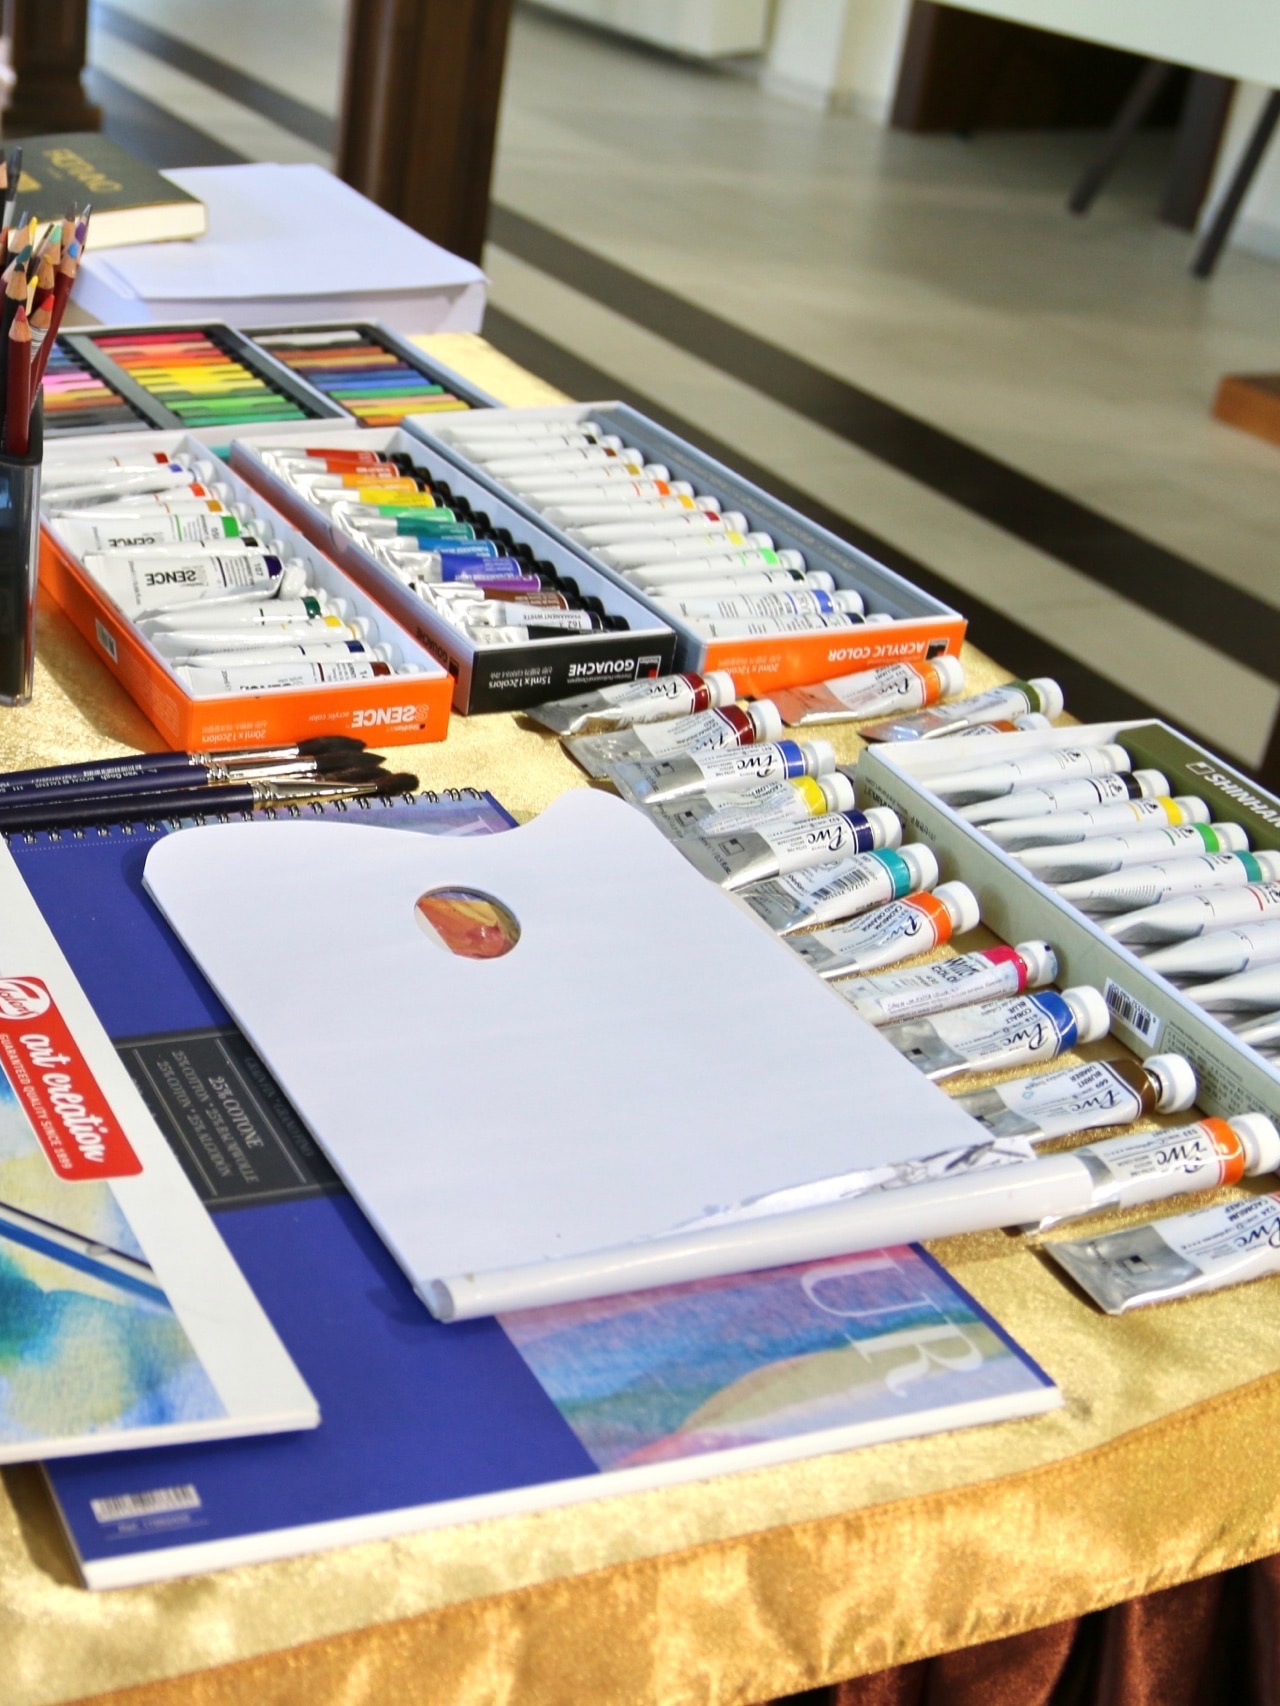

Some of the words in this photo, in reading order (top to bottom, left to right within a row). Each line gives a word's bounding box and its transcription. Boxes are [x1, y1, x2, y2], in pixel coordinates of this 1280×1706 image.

[254, 563, 262, 576] 107
[827, 646, 870, 661] COLOR
[874, 641, 925, 656] ACRYLIC
[567, 658, 634, 676] GOUACHE
[488, 677, 523, 690] 12colors
[529, 675, 550, 685] 15ml
[307, 713, 326, 722] color
[327, 710, 349, 720] acrylic
[244, 730, 265, 739] 20ml
[100, 771, 121, 780] Gogh
[805, 824, 848, 857] Pwc
[1005, 1007, 1031, 1024] COBALT
[1008, 1001, 1026, 1013] BLUE
[996, 1020, 1052, 1058] Pwc
[1068, 1064, 1095, 1081] UMBER
[1076, 1070, 1101, 1088] BURNT
[171, 1049, 190, 1067] 25%
[181, 1067, 210, 1101] COTTON
[205, 1108, 224, 1125] 25%
[19, 1032, 69, 1068] art
[45, 1074, 107, 1161] creation
[156, 1060, 174, 1076] 25%
[165, 1076, 192, 1107] COTON
[186, 1113, 207, 1133] 25%
[207, 1075, 234, 1097] 25%
[221, 1099, 264, 1149] COTONE
[22, 1085, 48, 1119] QUALITY
[40, 1120, 60, 1145] SINCE
[53, 1147, 72, 1169] 1899
